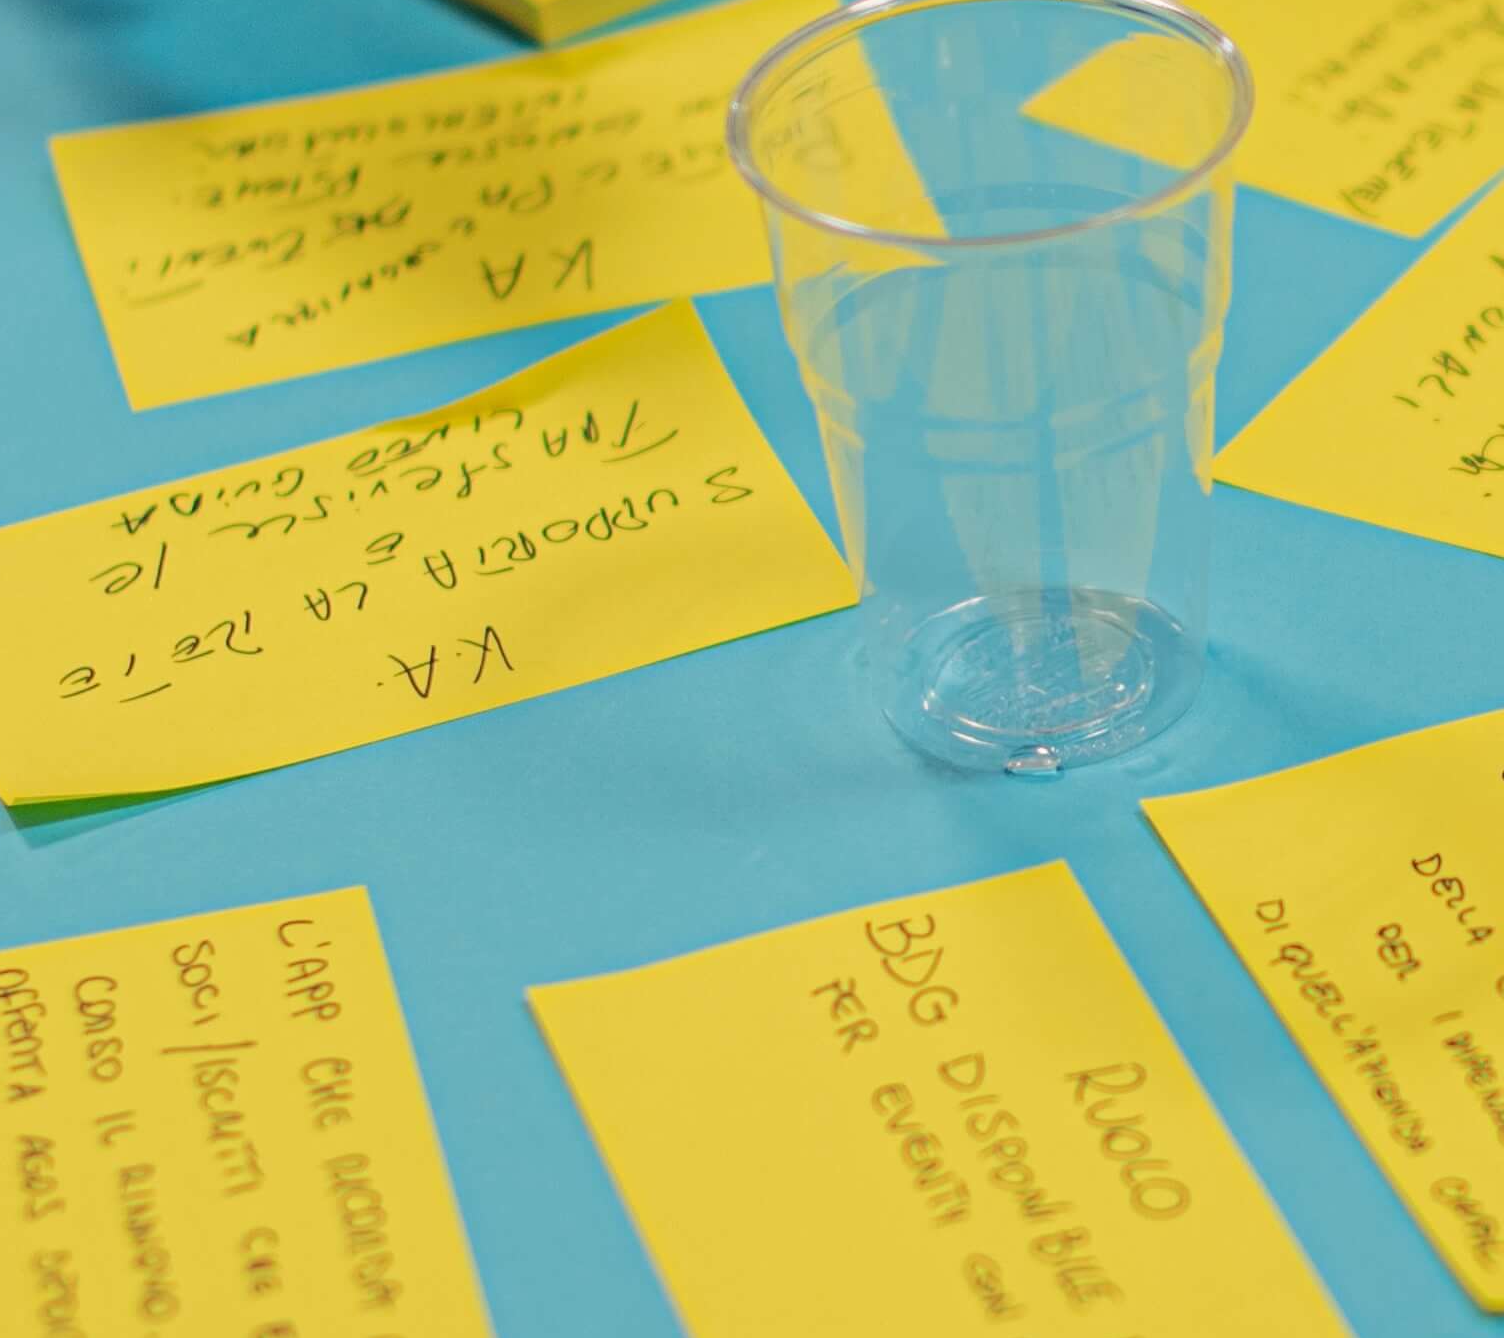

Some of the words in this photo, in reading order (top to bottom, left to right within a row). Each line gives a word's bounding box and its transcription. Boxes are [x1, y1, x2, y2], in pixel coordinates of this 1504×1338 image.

[474, 233, 600, 307] KA
[301, 578, 372, 625] LA
[1407, 849, 1498, 949] DELLA
[271, 913, 347, 1027] L'APP
[859, 908, 965, 1032] BDG
[1372, 919, 1425, 985] PER
[67, 970, 129, 1087] CORSO
[805, 973, 884, 1059] PER
[90, 1107, 141, 1151] IL
[295, 1052, 359, 1136] CHE
[1059, 1057, 1196, 1226] RUOLO
